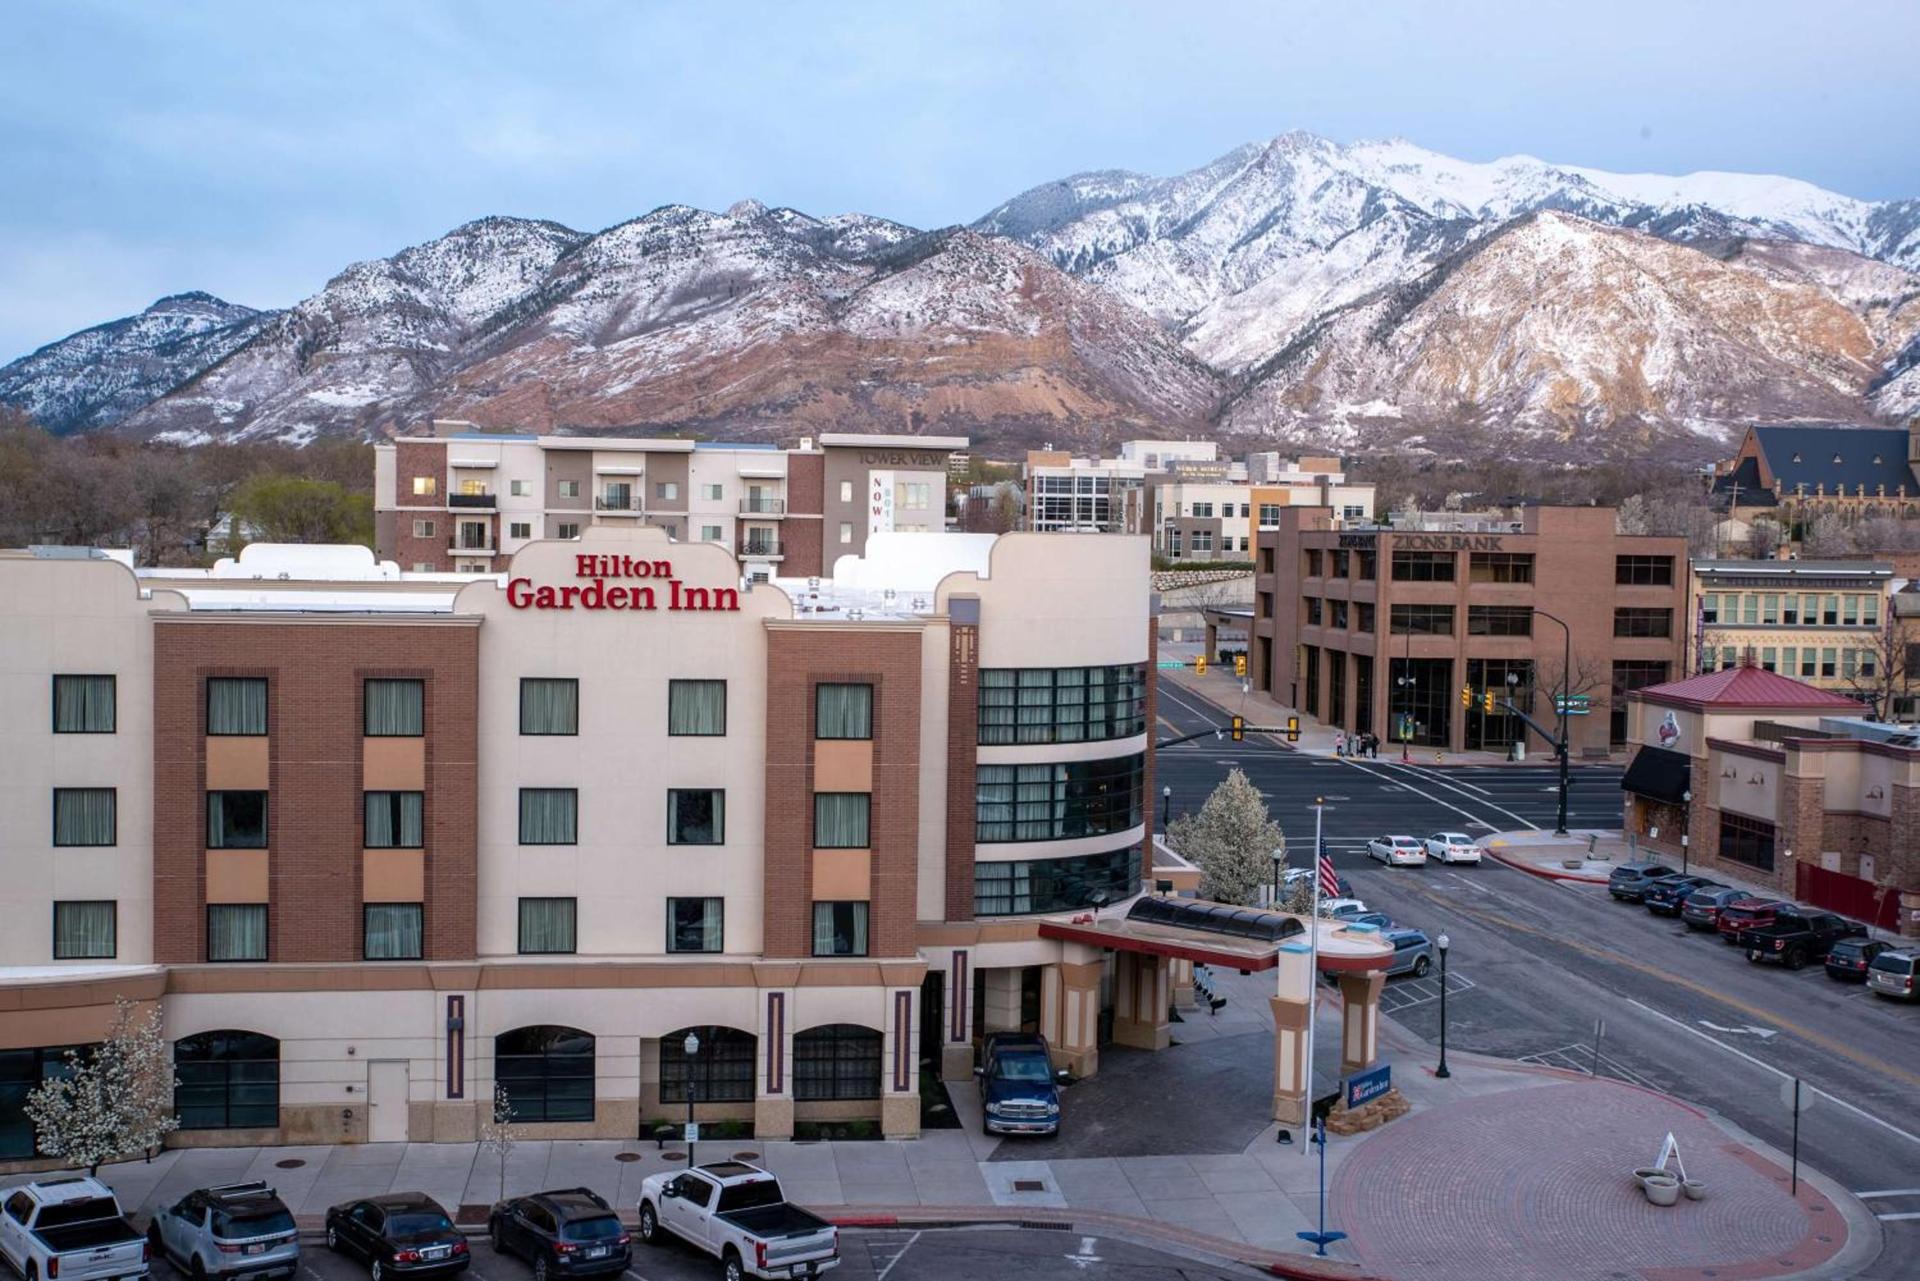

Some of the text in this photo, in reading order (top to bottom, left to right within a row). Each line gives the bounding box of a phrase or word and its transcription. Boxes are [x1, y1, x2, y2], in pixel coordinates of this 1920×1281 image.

[860, 452, 945, 466] TOWER VIEW
[873, 478, 882, 516] NOW
[1392, 535, 1505, 551] ZIONS BANK
[576, 554, 673, 578] Hilton
[506, 577, 741, 611] Garden Inn
